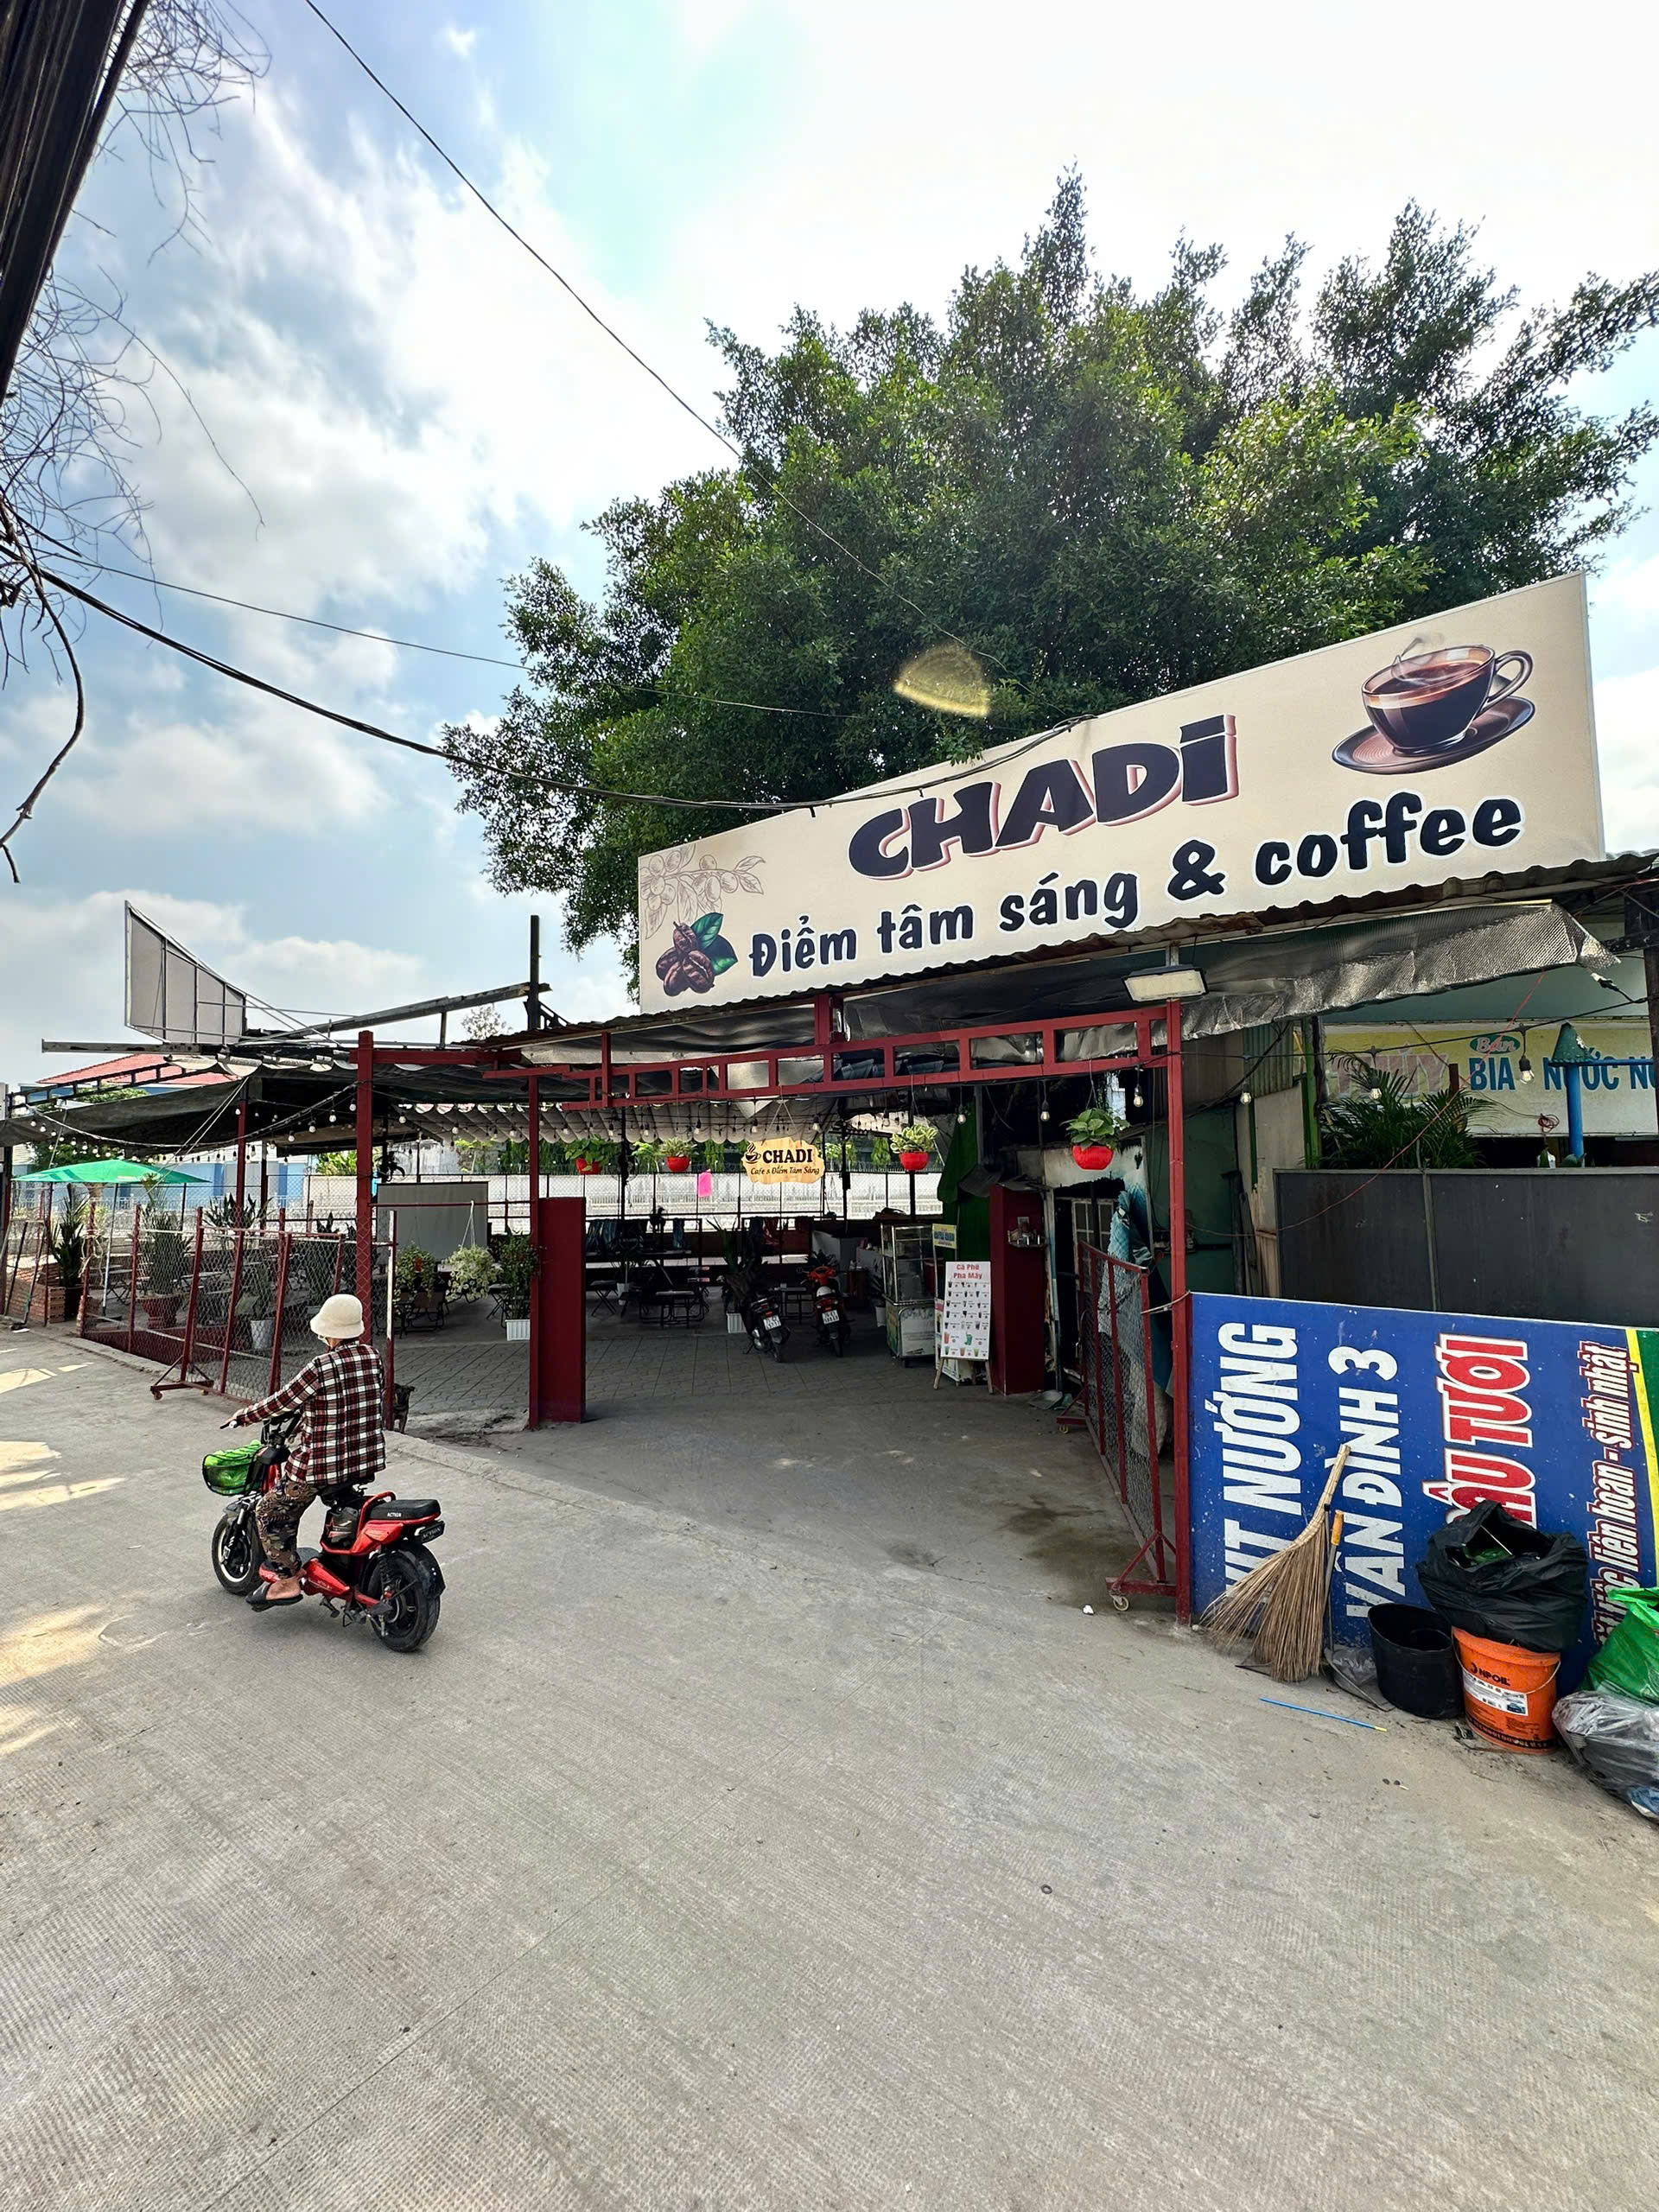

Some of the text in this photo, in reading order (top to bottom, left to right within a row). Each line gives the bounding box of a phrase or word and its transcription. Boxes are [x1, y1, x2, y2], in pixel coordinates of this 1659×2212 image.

[751, 791, 1522, 977] Điểm tâm sáng & coffee
[1469, 1057, 1516, 1091] BIA
[762, 1148, 813, 1164] CHADI
[1328, 1345, 1398, 1382] 3
[1580, 1341, 1640, 1400] nhật
[1205, 1321, 1303, 1516] NƯỚNG
[1325, 1387, 1403, 1507] ĐÌNH
[1421, 1332, 1537, 1528] ÂU TƯƠI
[1584, 1398, 1633, 1450] sinh
[1588, 1460, 1636, 1523] hoan
[1588, 1522, 1639, 1573] liên
